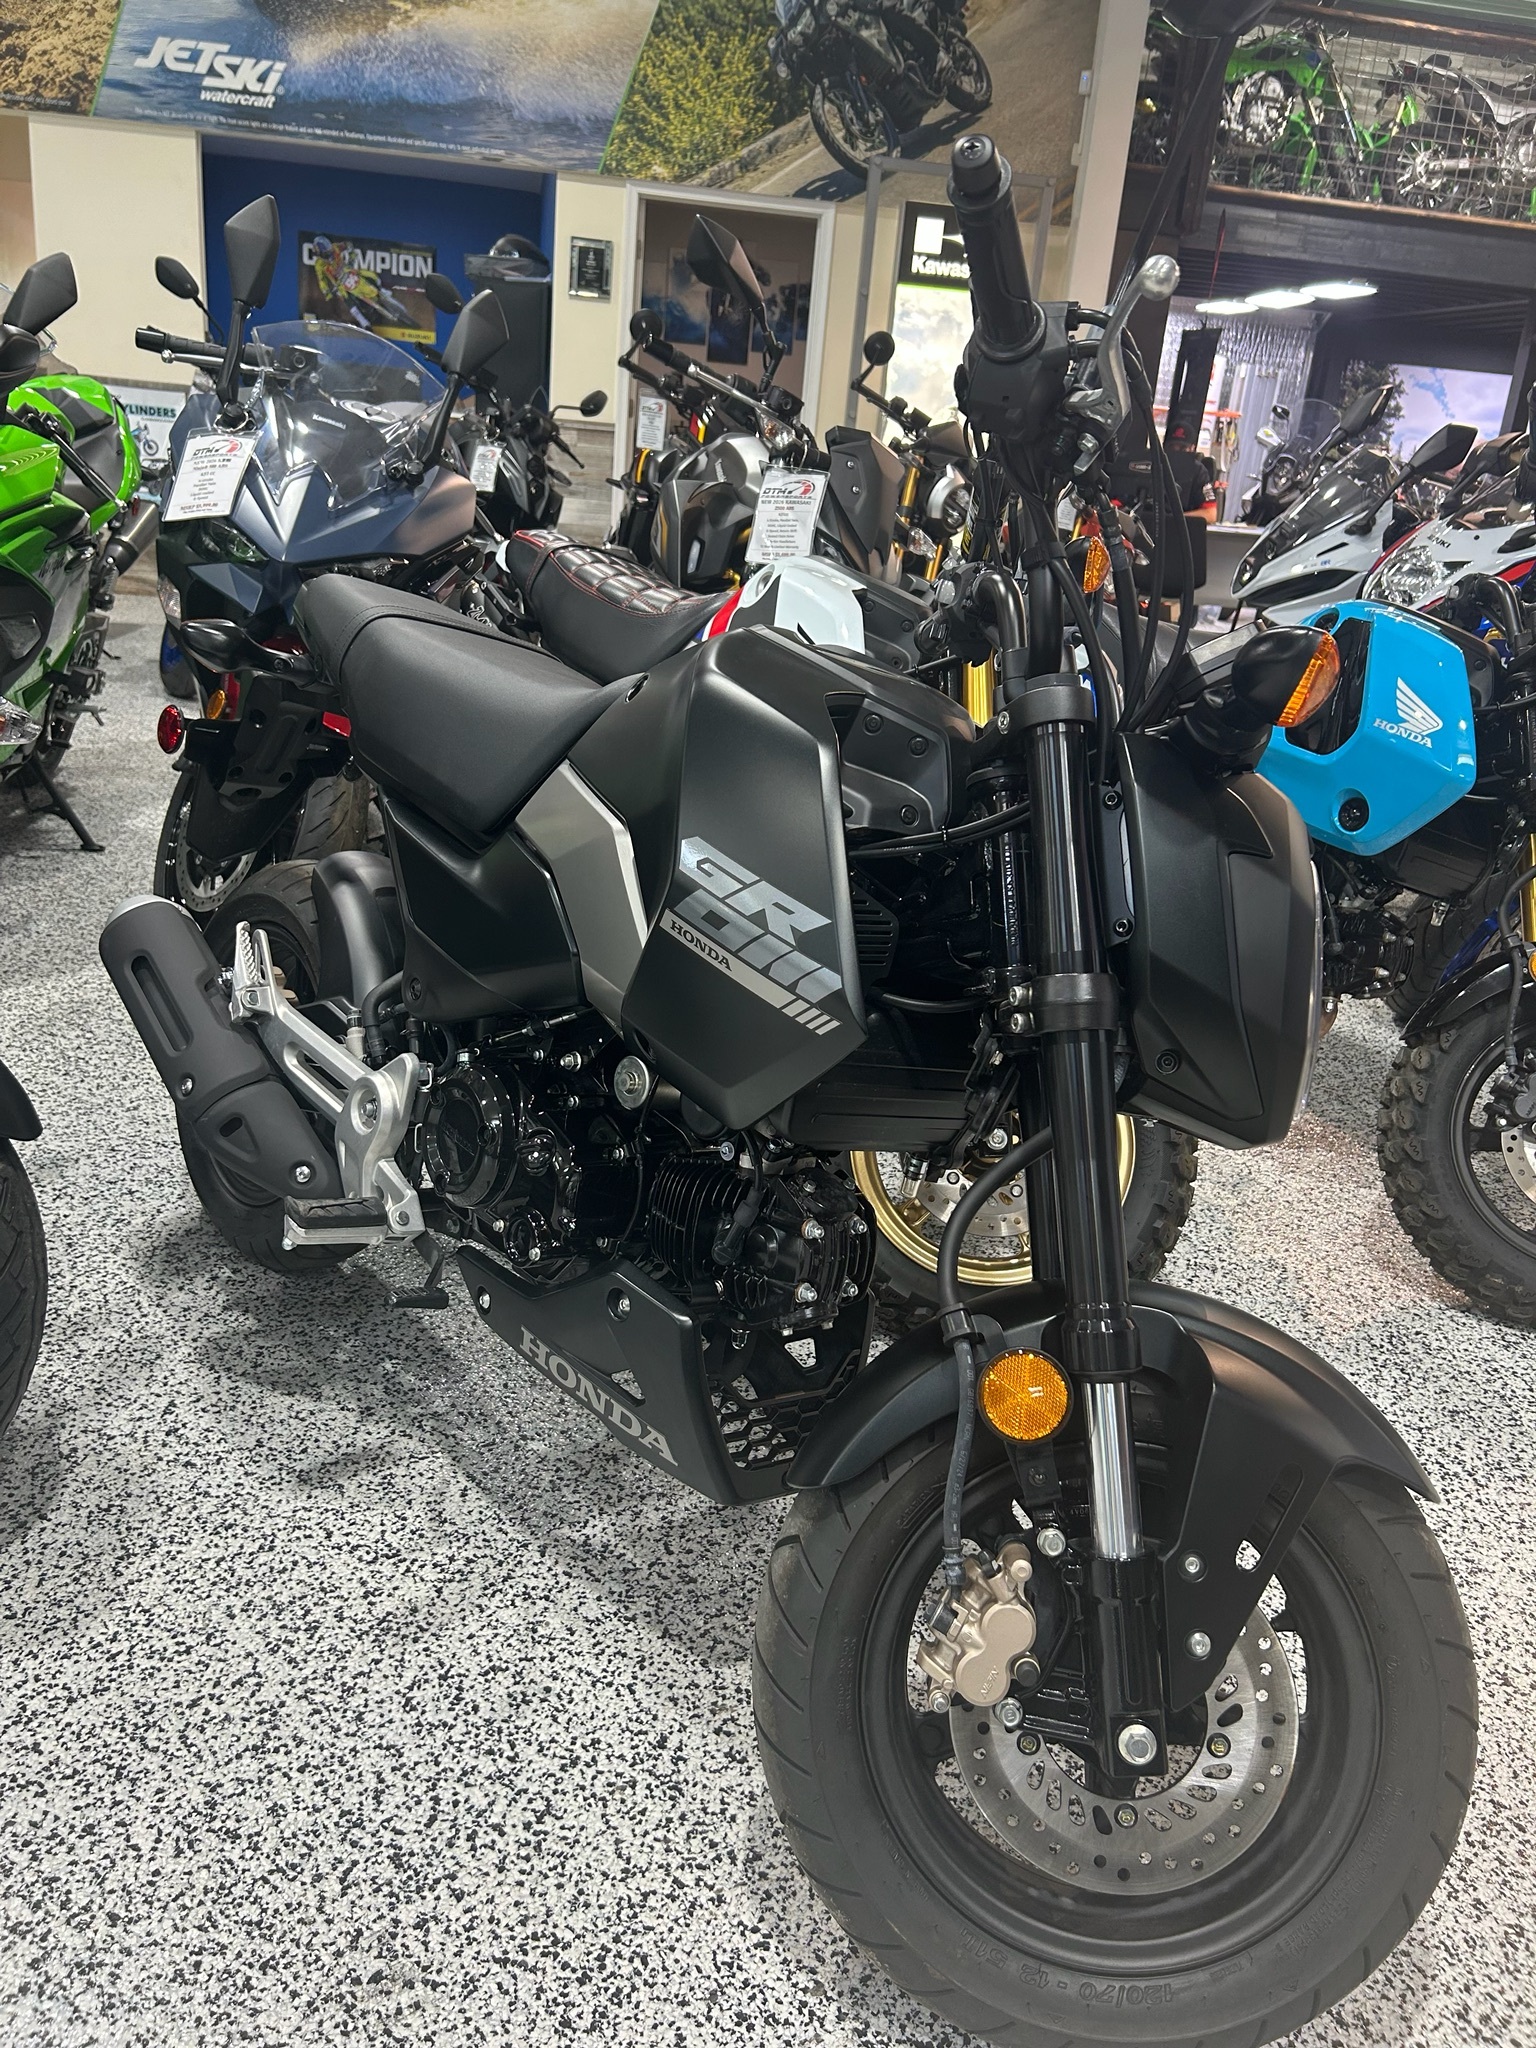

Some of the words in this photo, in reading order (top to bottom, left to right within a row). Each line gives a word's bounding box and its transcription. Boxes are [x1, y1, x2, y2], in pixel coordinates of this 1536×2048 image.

[200, 89, 277, 109] watercraft
[302, 242, 433, 279] CMPION
[911, 254, 972, 279] Kawas
[124, 403, 177, 418] YLINDERS
[1373, 718, 1433, 749] HONDA
[670, 919, 733, 972] HONDA
[519, 1323, 679, 1467] HONDA
[1079, 1982, 1174, 2008] 120/70
